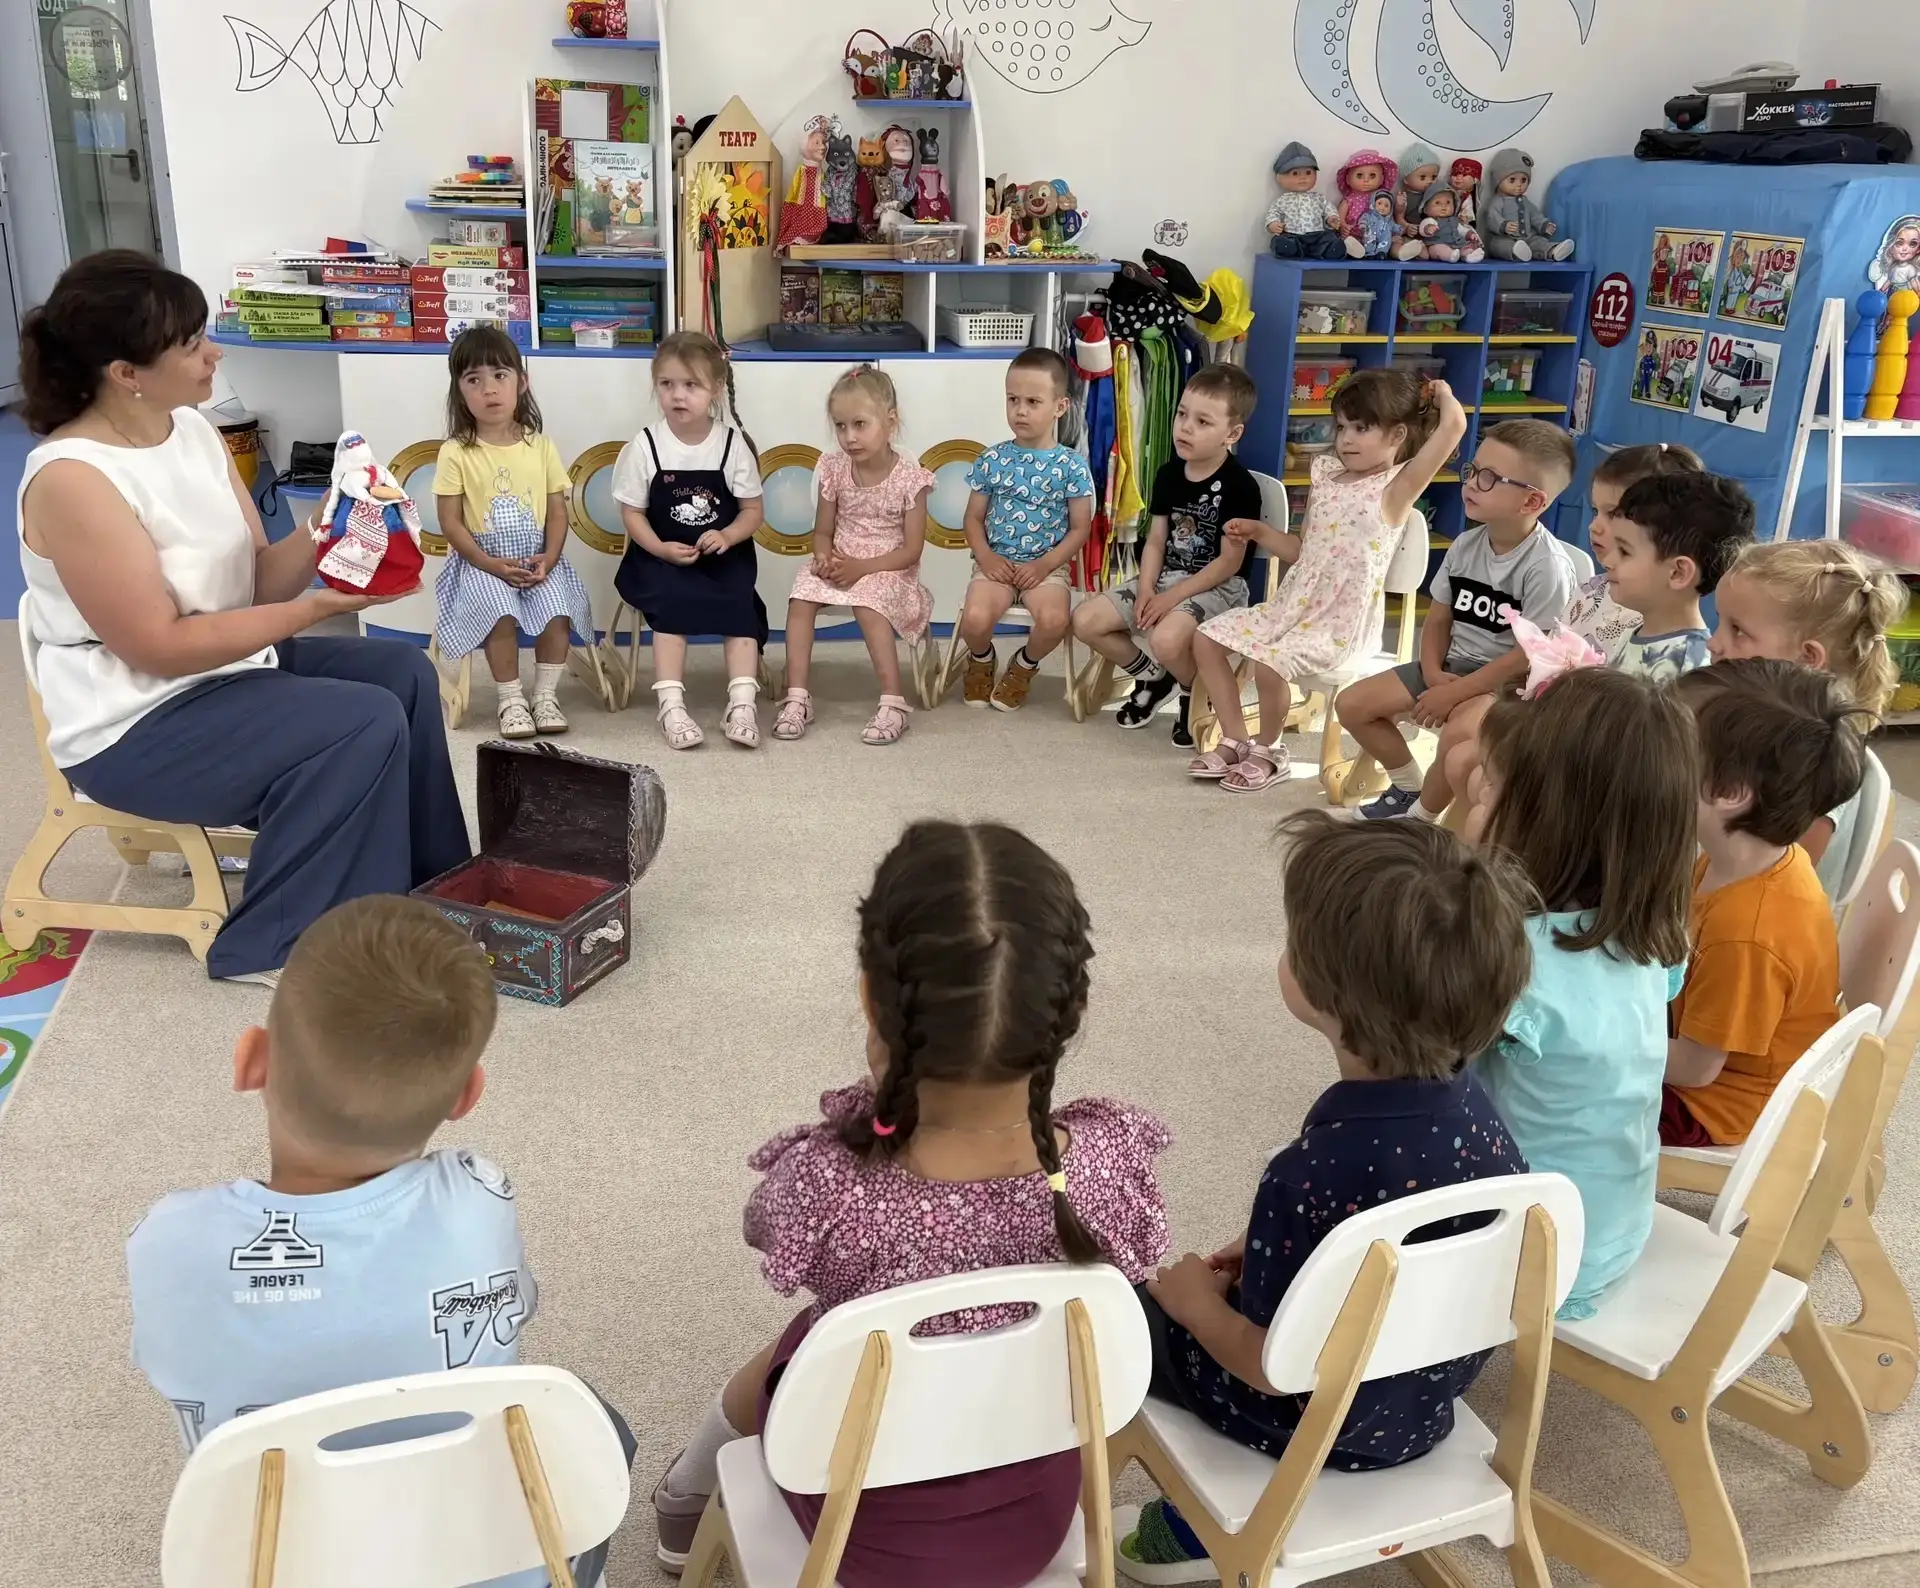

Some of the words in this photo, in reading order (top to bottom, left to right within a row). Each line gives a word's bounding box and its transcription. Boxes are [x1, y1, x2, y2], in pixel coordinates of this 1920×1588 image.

[1752, 103, 1795, 117] ХОККЕЙ
[719, 131, 757, 147] ТЕАТР
[477, 248, 497, 257] MAXI
[1687, 241, 1715, 264] 101
[1764, 247, 1798, 273] 103
[324, 267, 334, 276] IQ
[424, 275, 439, 283] Trefl
[377, 286, 402, 294] Puzzle
[425, 301, 440, 309] Trefl
[1594, 293, 1628, 322] 112
[426, 326, 441, 334] Trefl
[1670, 337, 1698, 361] 102
[1707, 336, 1734, 367] 04
[672, 486, 694, 498] Hello
[694, 485, 714, 500] Kitty
[249, 1274, 304, 1288] LEAGUE
[232, 1290, 260, 1304] THE
[288, 1287, 323, 1302] KING
[440, 1279, 518, 1316] Basketball
